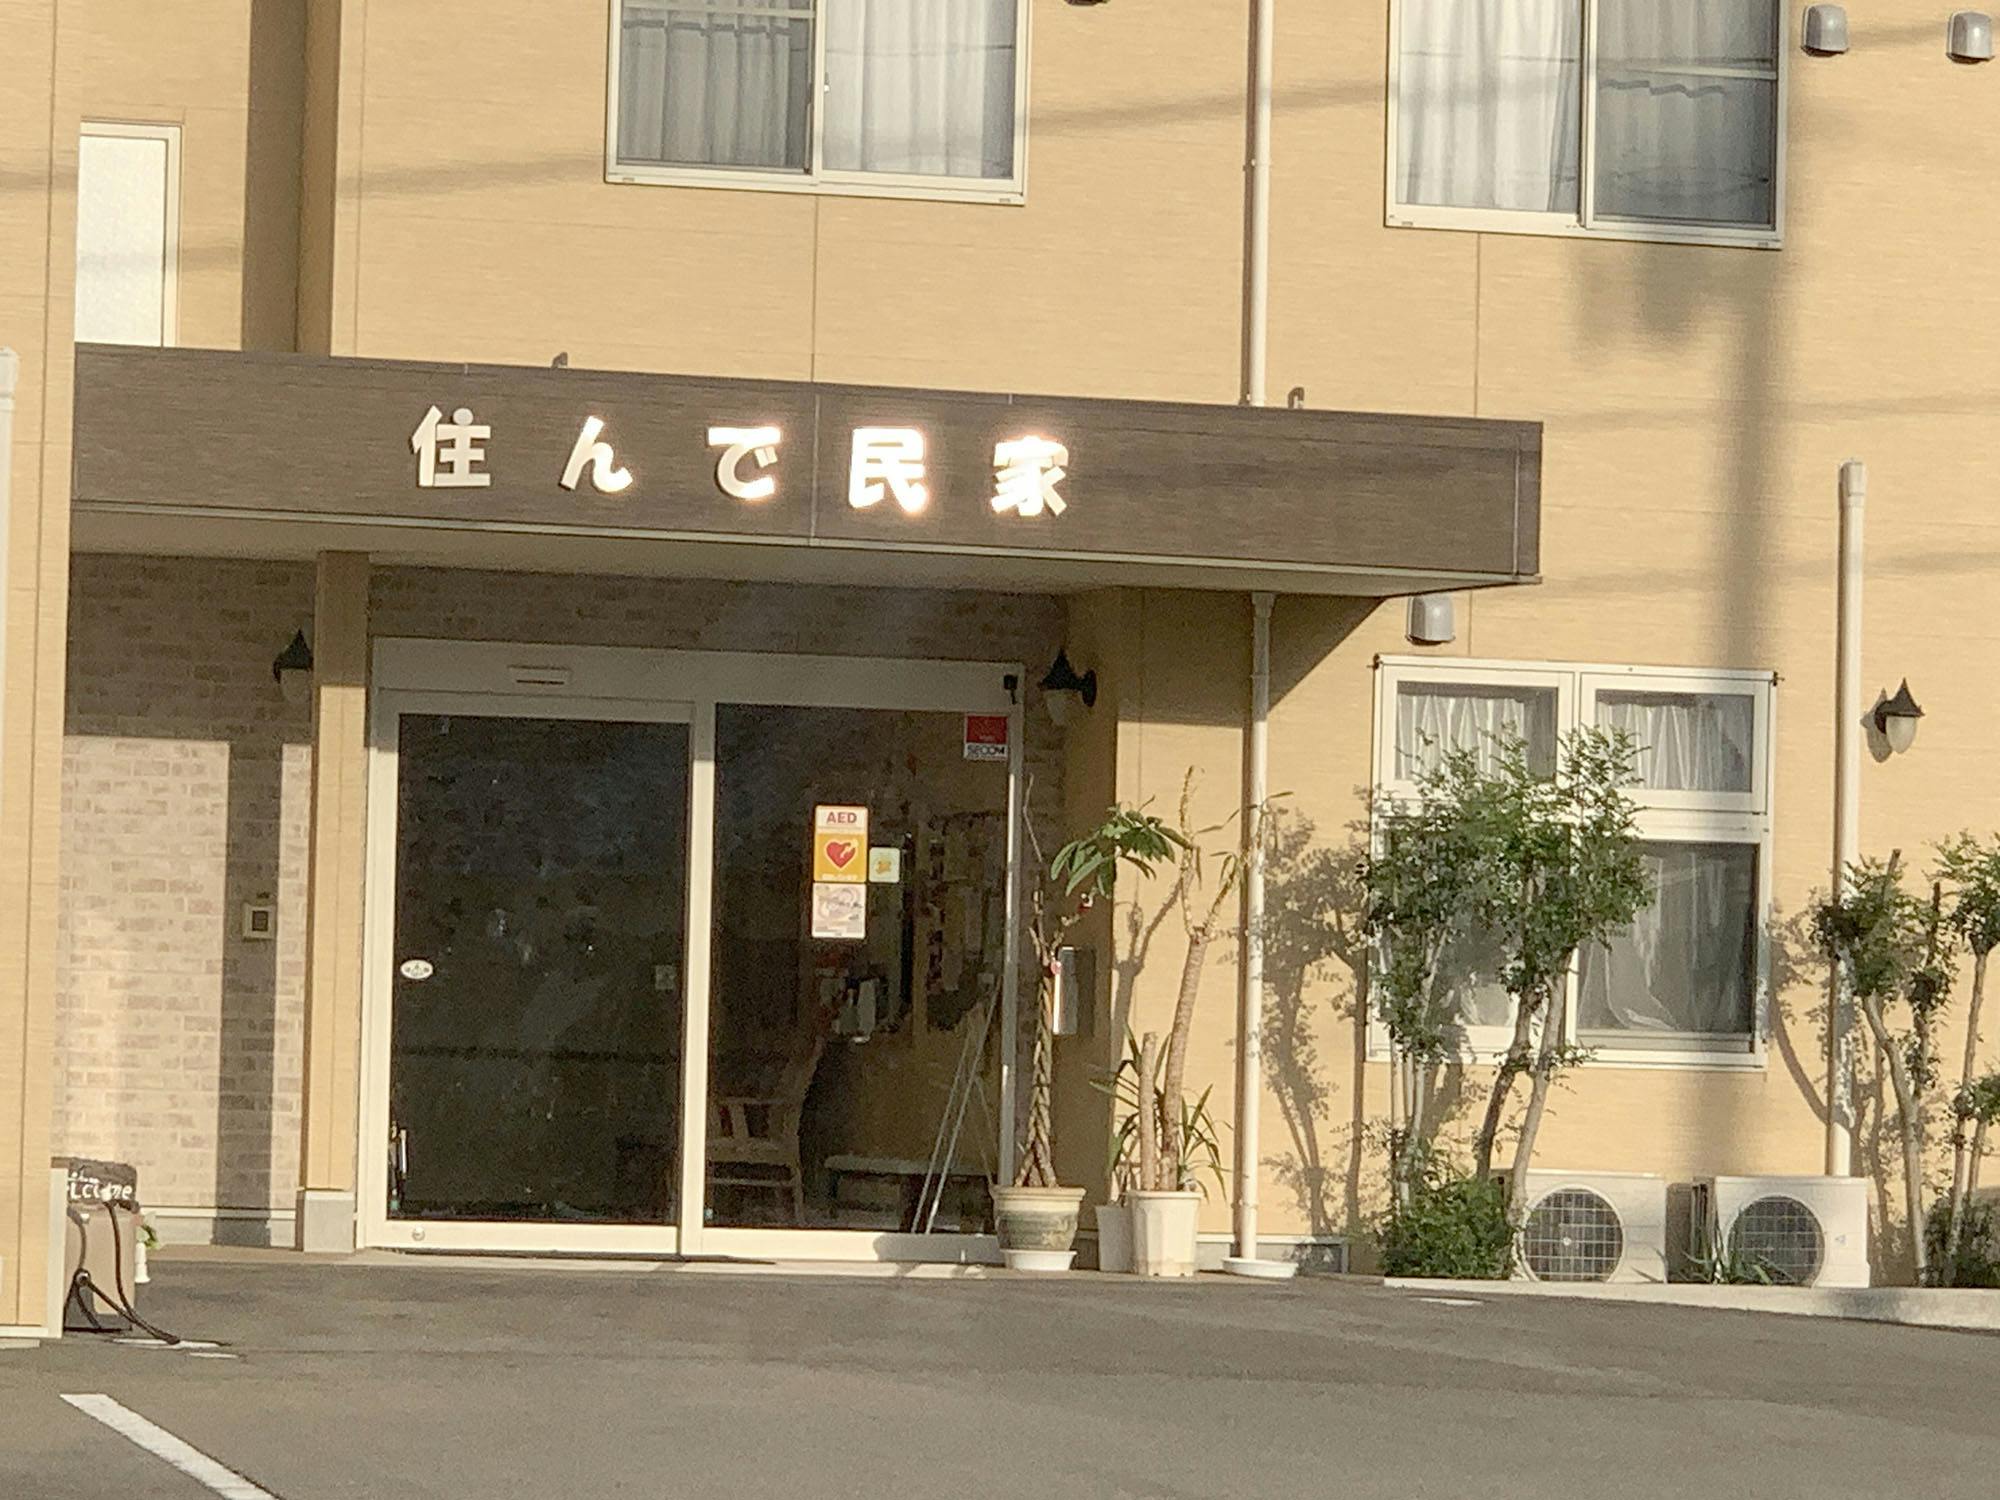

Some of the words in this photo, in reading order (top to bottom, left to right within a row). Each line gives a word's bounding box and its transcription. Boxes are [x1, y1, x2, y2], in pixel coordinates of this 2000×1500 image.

[410, 404, 1070, 517] 住んで民家
[826, 811, 858, 824] AED
